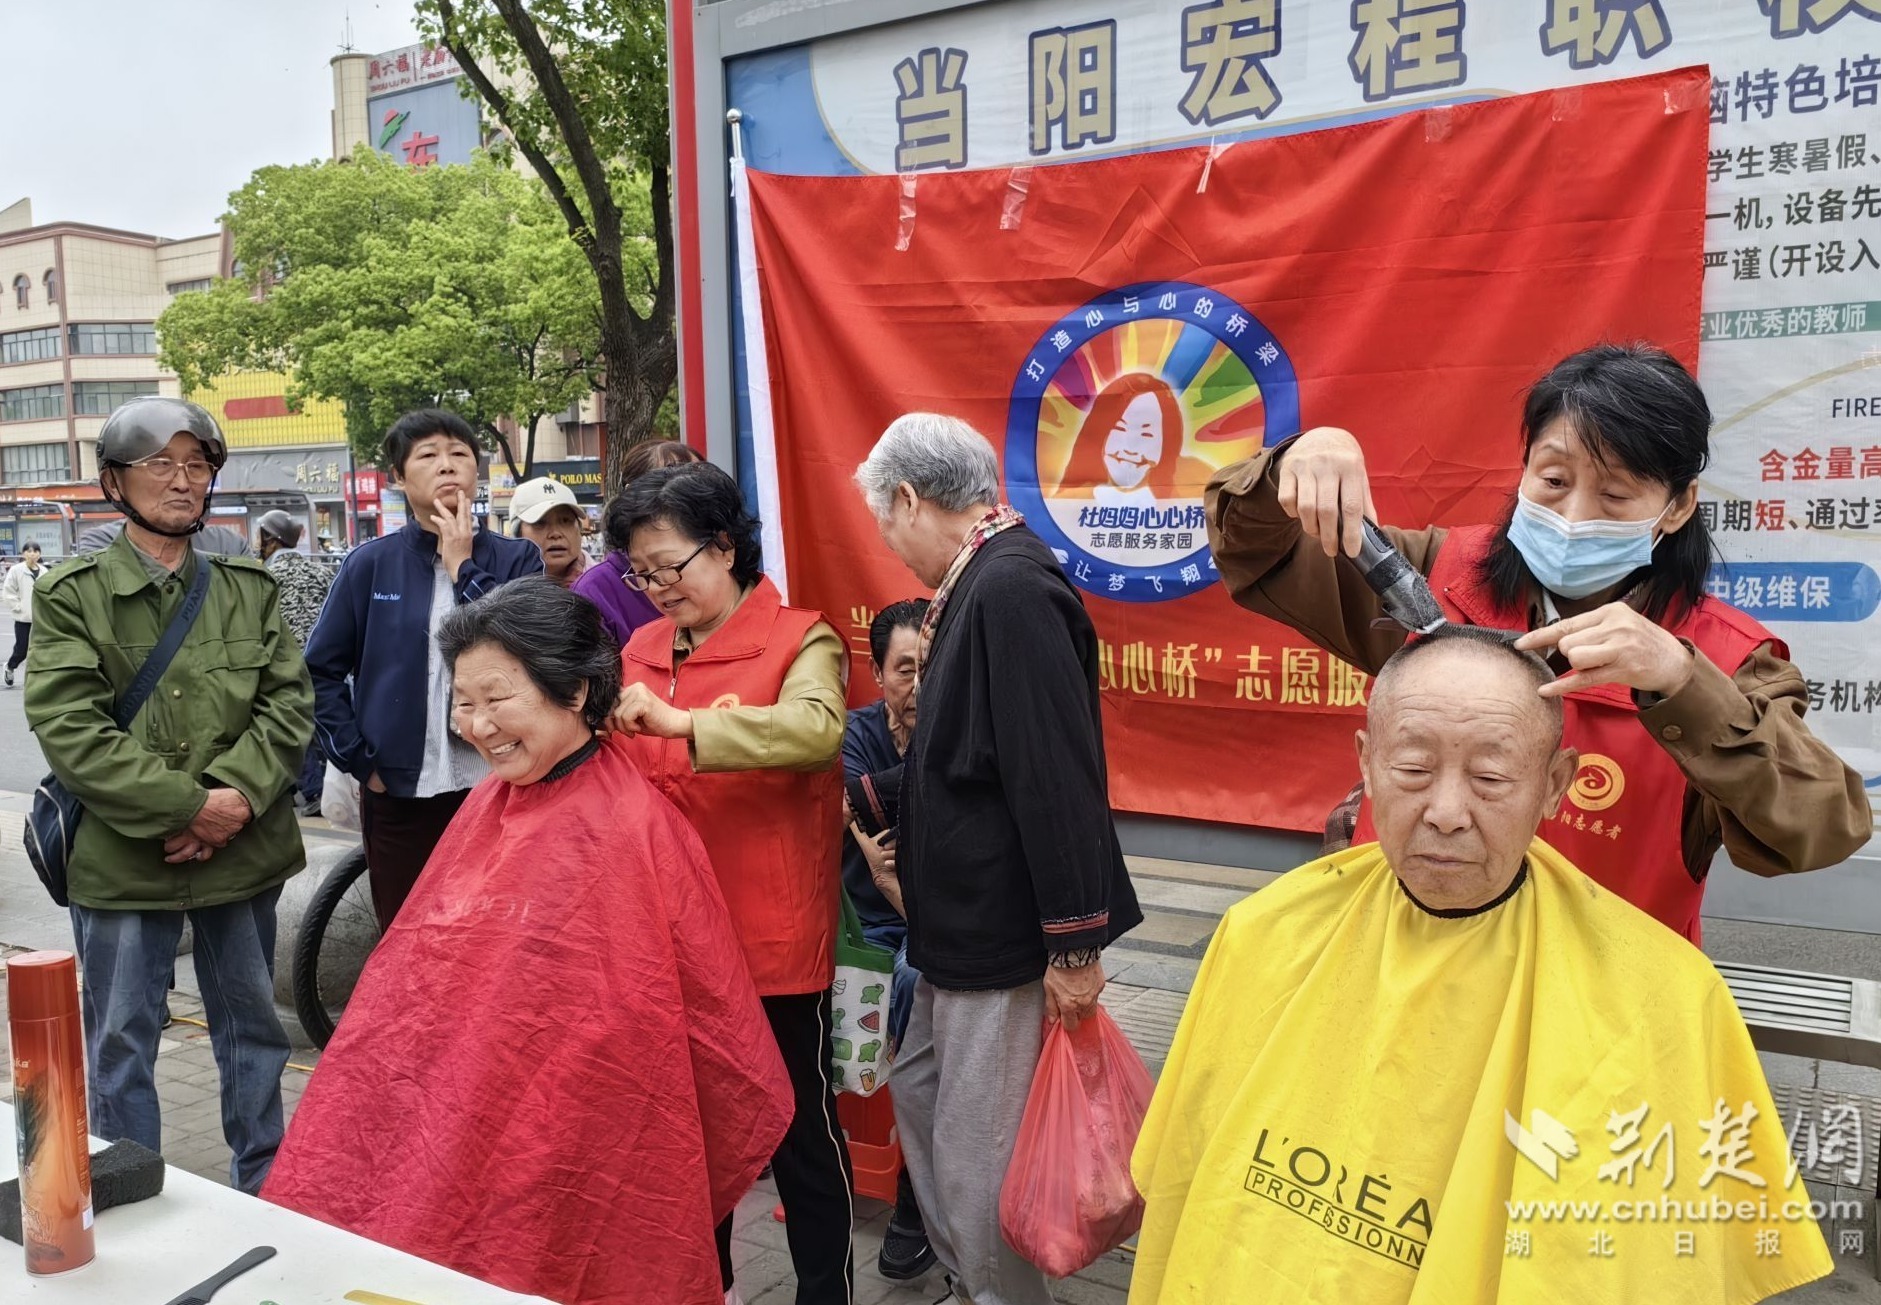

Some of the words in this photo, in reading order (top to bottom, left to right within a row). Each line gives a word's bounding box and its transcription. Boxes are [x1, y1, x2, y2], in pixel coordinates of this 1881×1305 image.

[1026, 292, 1280, 382] 打造心与心的桥梁
[1832, 397, 1881, 418] FIRE
[295, 462, 340, 483] 周六福
[1759, 445, 1881, 482] 含金量高
[1078, 505, 1205, 530] 杜妈妈心心桥
[1090, 532, 1193, 550] 志愿服务家园
[1074, 560, 1201, 593] 让梦飞翔
[1705, 575, 1831, 610] 中级维保
